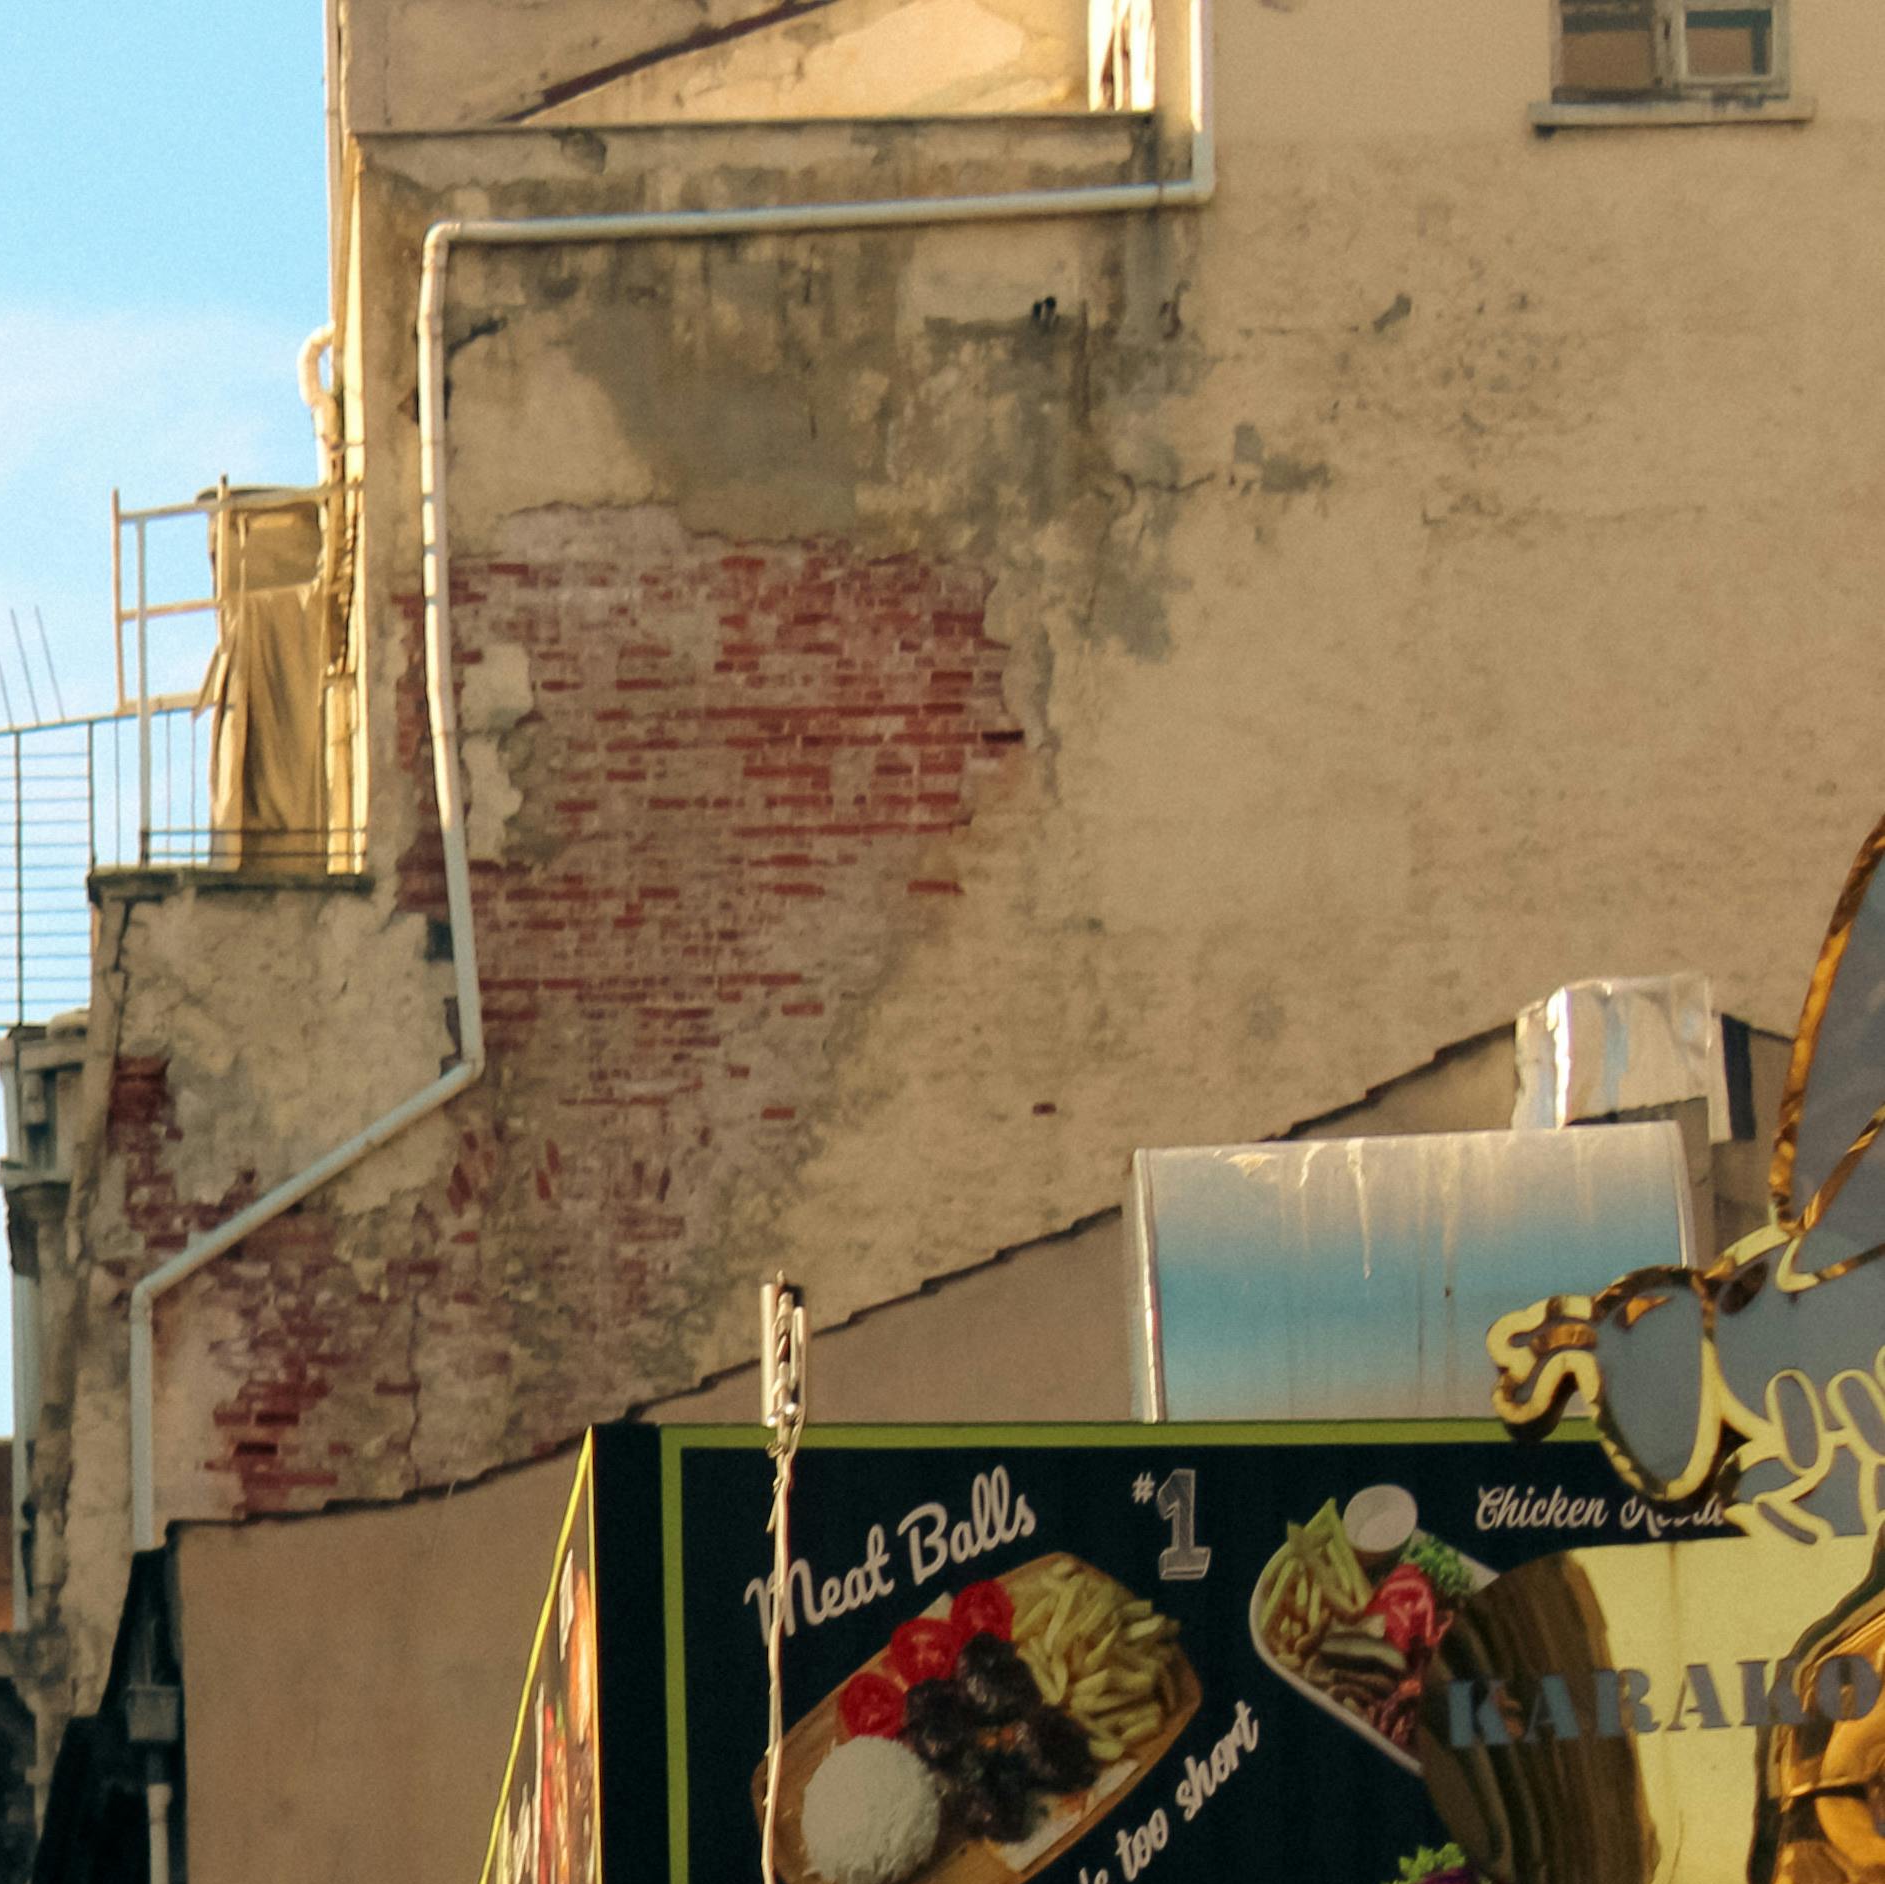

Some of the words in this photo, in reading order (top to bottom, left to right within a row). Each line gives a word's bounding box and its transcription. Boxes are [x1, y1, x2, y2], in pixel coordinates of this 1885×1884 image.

[743, 1521, 896, 1648] Meat
[897, 1463, 1038, 1588] Balls
[1473, 1483, 1609, 1532] Chicken
[1113, 1808, 1171, 1881] too
[1174, 1696, 1262, 1823] short
